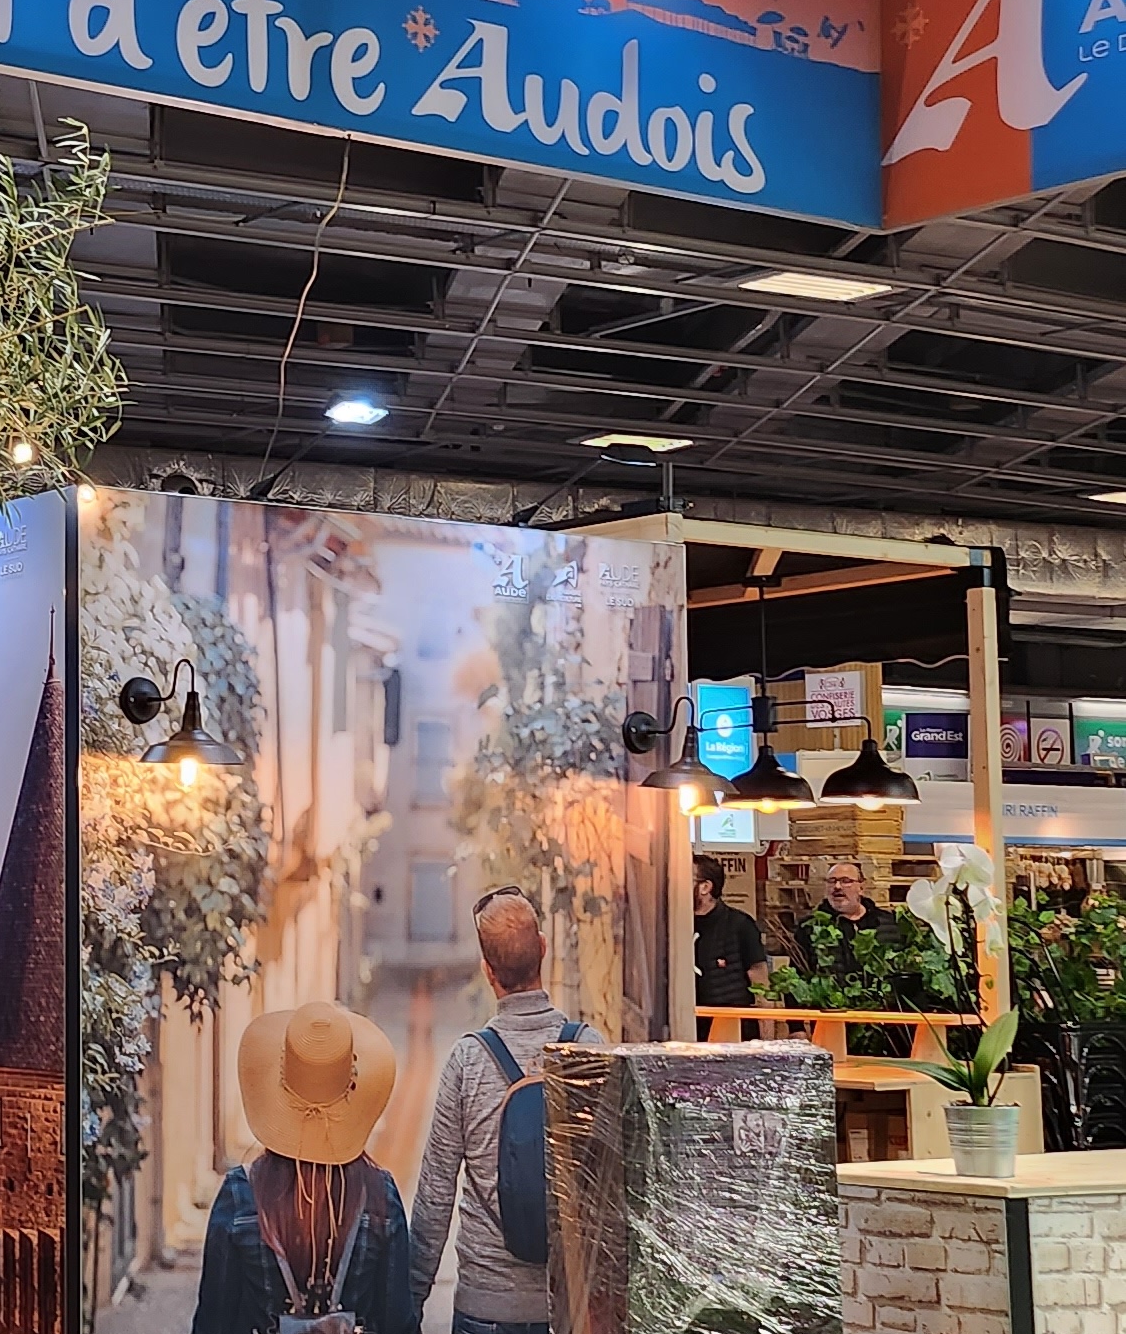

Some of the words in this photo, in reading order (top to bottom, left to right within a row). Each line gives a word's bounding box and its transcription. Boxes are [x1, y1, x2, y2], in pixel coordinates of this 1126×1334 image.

[412, 17, 767, 197] Audois
[910, 730, 947, 742] Grand
[947, 731, 964, 742] Est
[1019, 803, 1058, 818] RAFFIN
